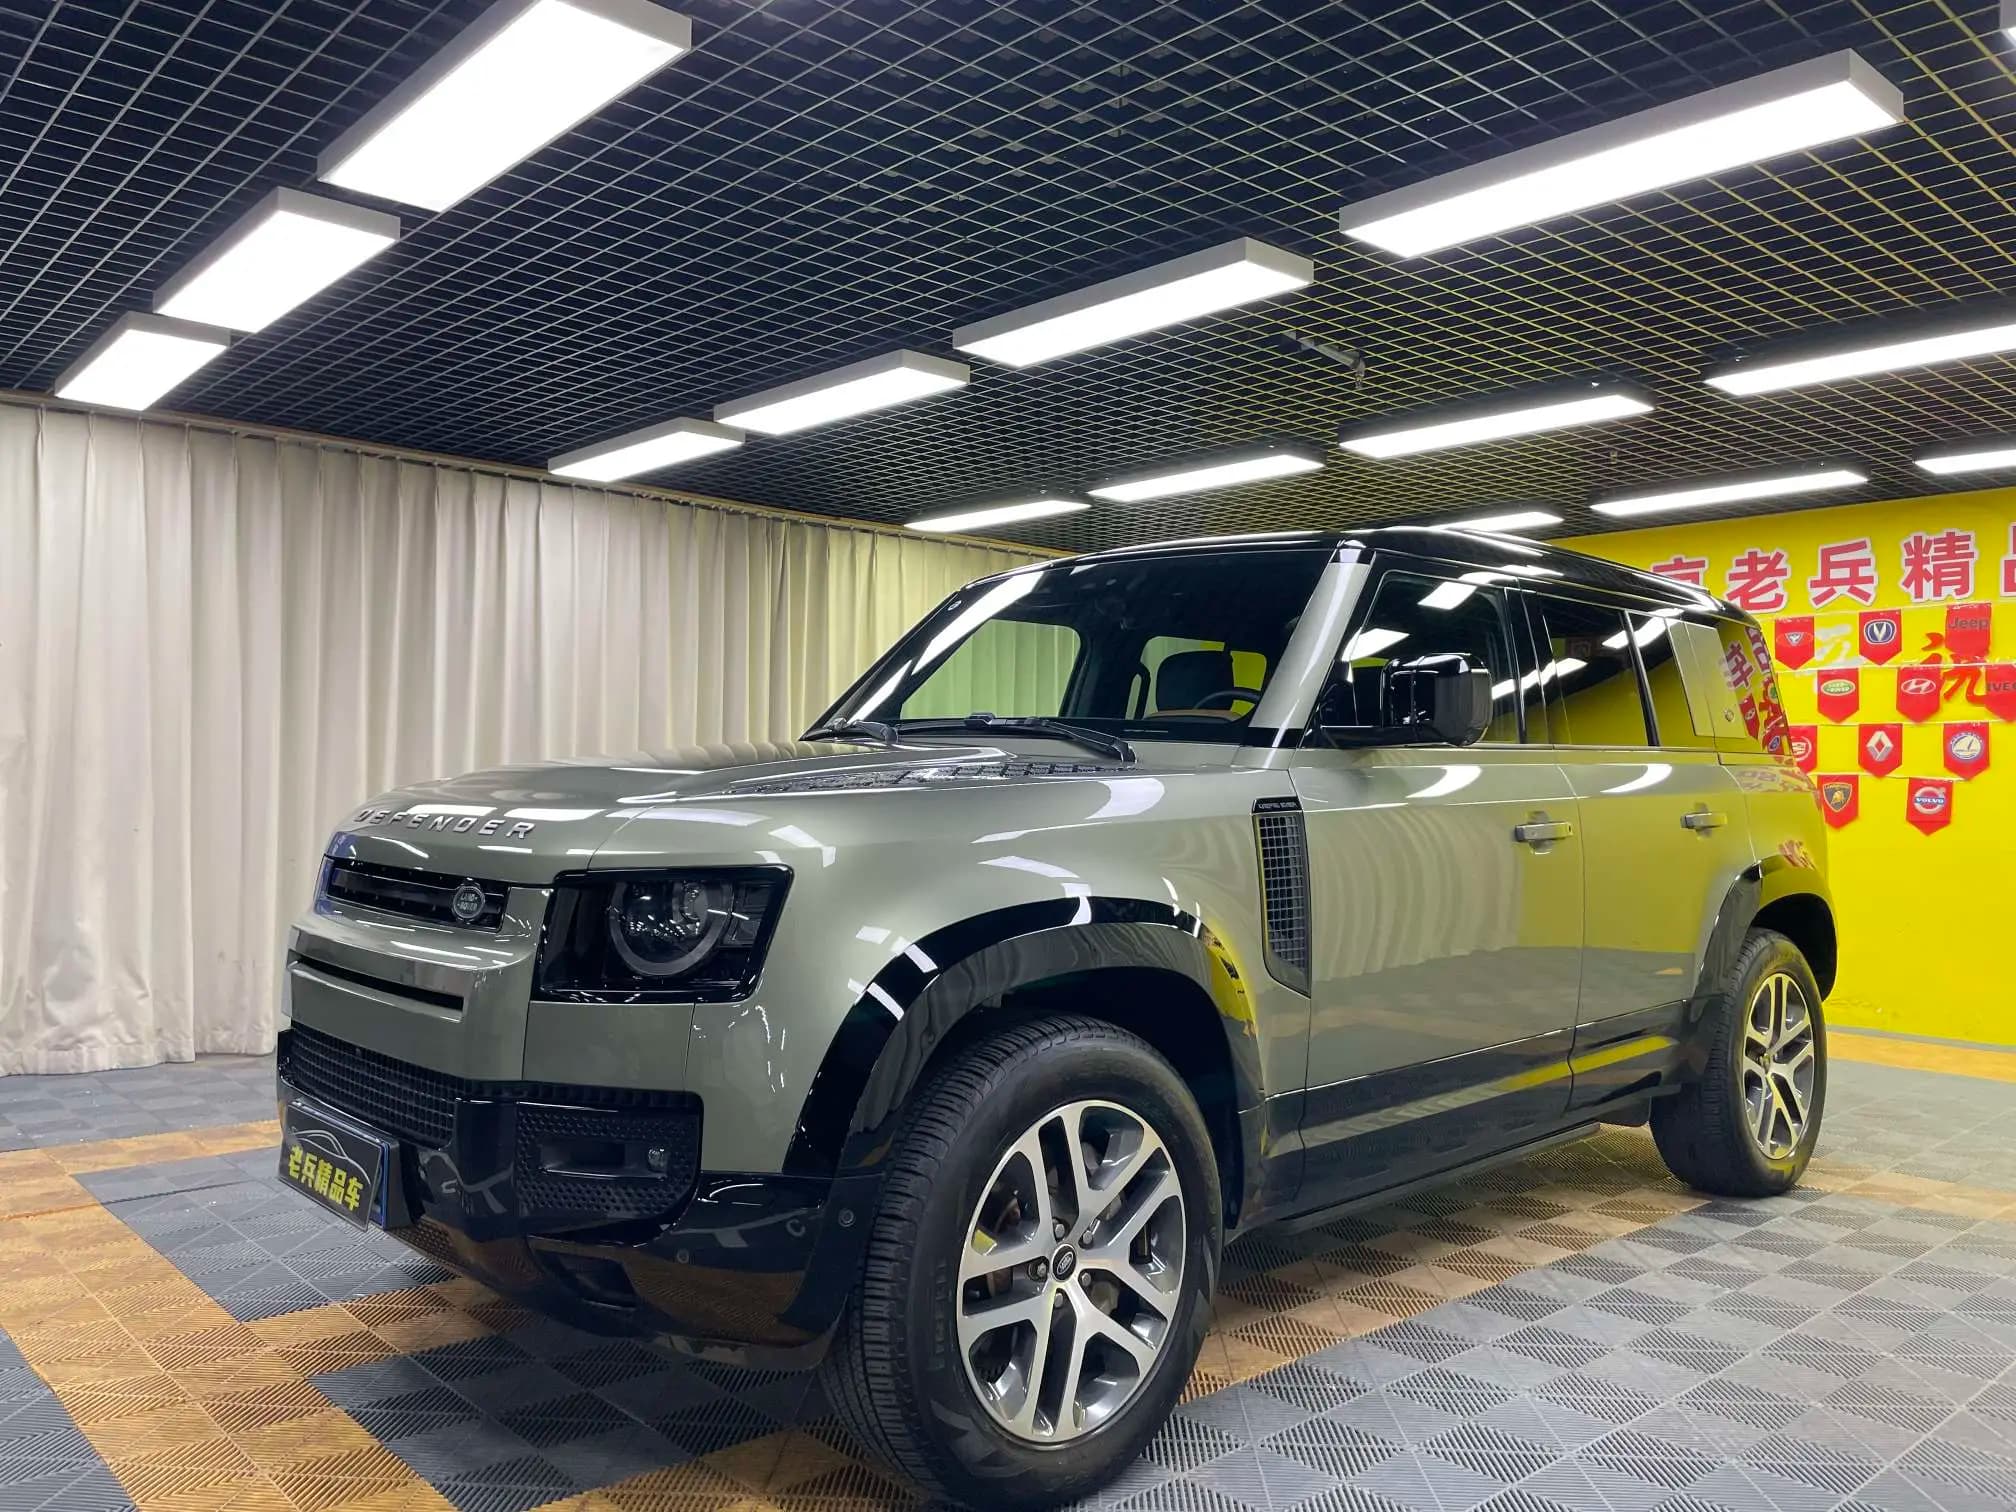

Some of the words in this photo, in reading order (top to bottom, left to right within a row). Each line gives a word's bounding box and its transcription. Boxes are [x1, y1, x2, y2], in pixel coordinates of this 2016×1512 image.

[1652, 524, 2016, 612] 老兵精
[1949, 615, 1990, 631] Jeep
[354, 809, 536, 839] DEFENDER
[288, 1145, 363, 1211] 老兵精品车
